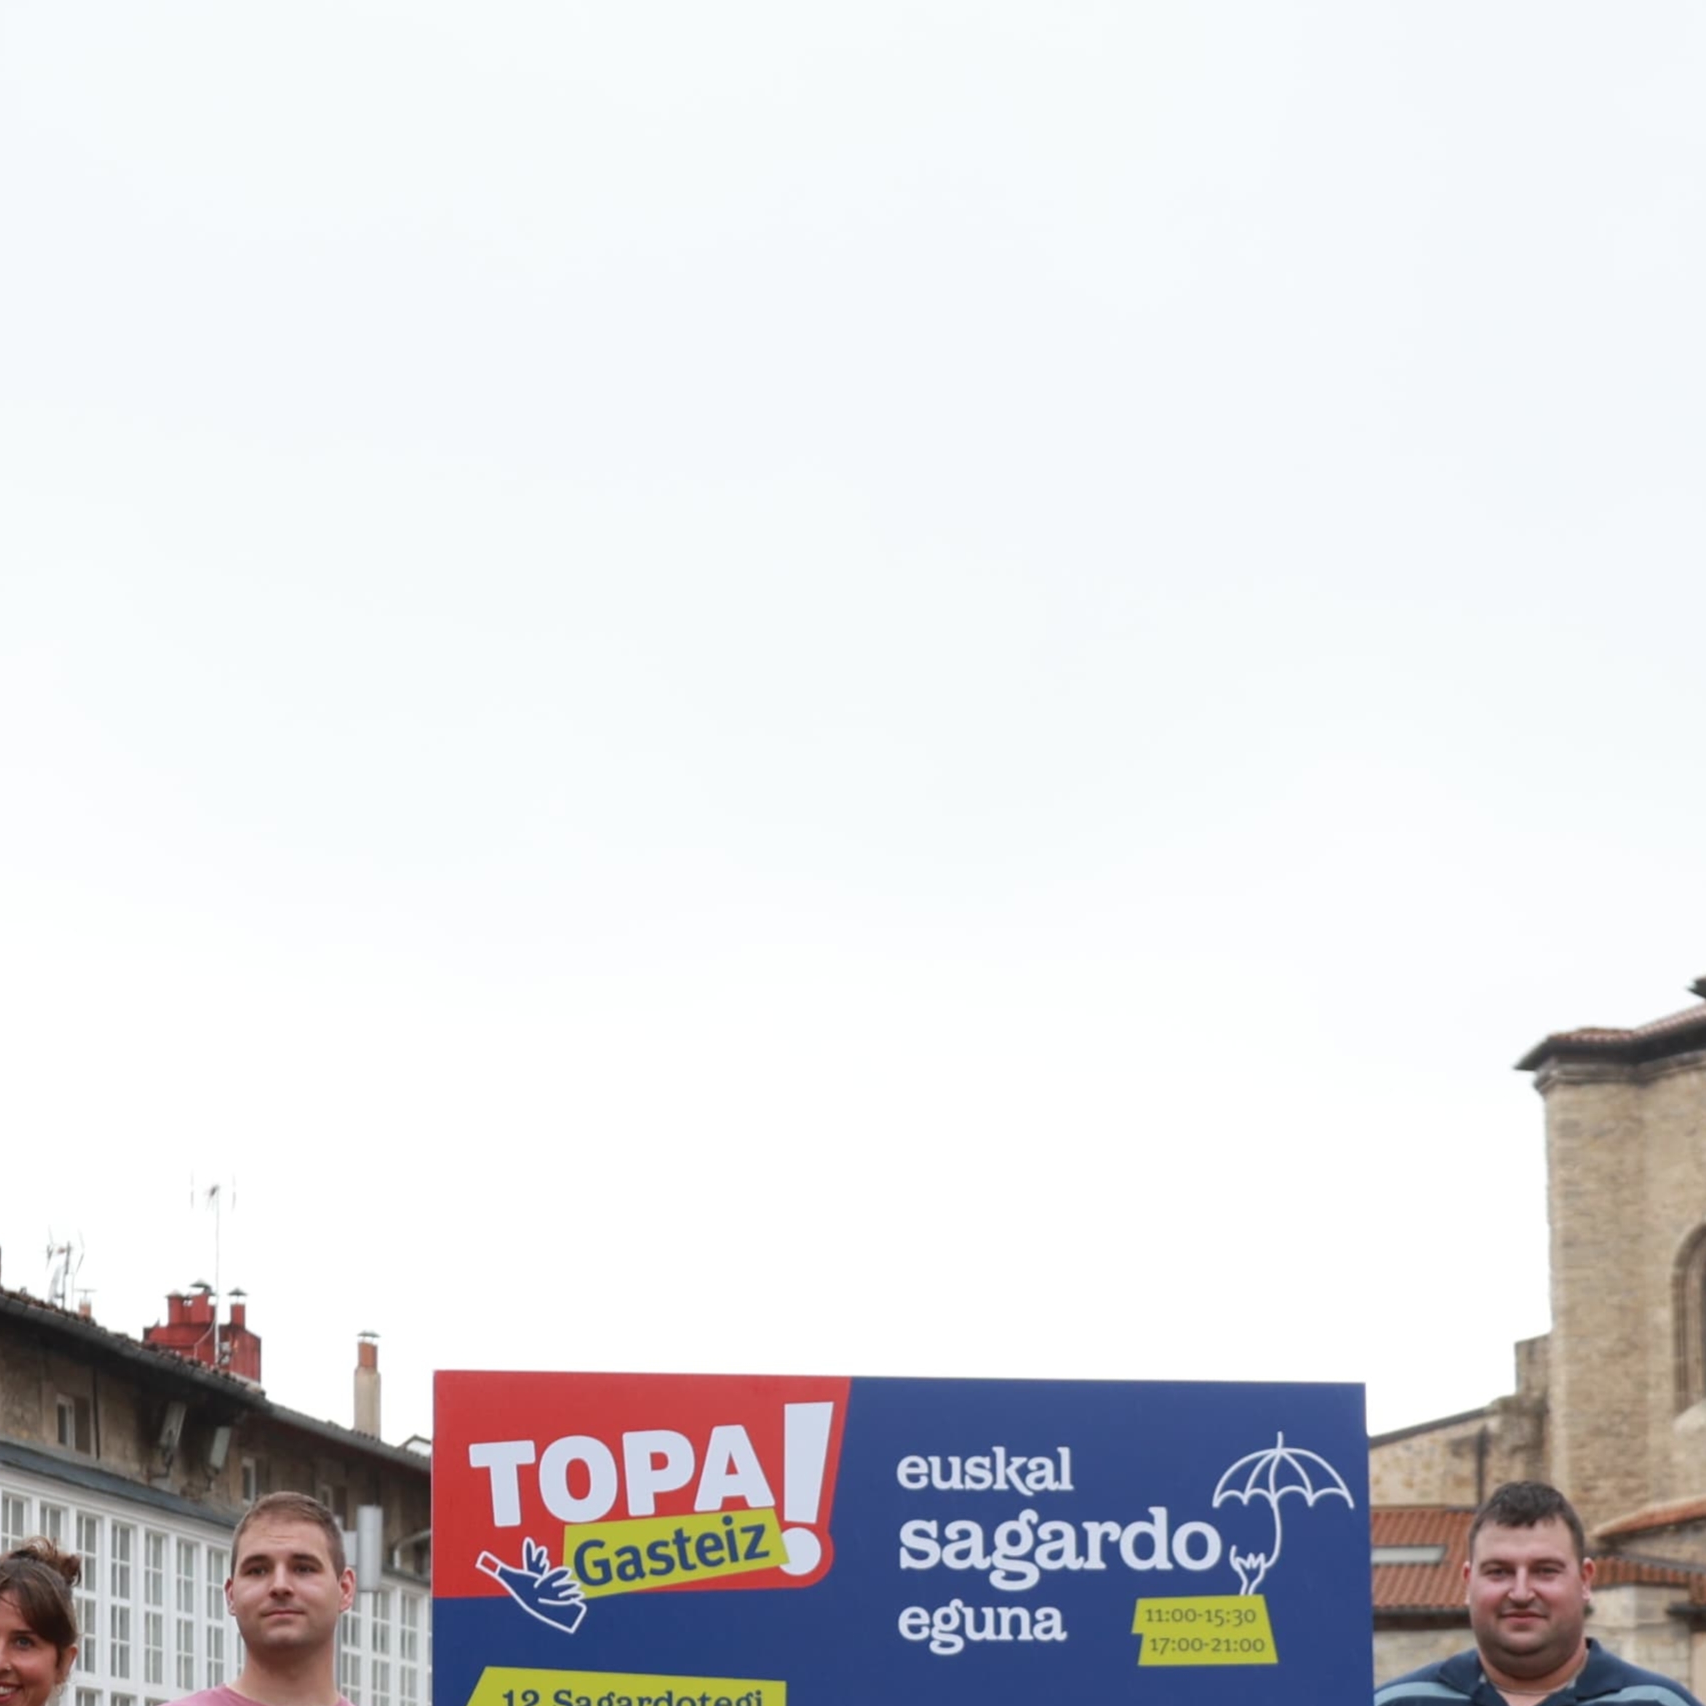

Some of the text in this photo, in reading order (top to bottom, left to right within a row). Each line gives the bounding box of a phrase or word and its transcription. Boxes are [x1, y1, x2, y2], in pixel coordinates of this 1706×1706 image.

[468, 1401, 834, 1576] TOPA!
[896, 1446, 1074, 1496] euskal
[573, 1514, 770, 1587] Gasteiz
[899, 1506, 1222, 1591] sagardo
[897, 1598, 1067, 1656] eguna
[1144, 1607, 1257, 1628] 11:00-15:30
[1149, 1636, 1265, 1655] 17:00-21:00
